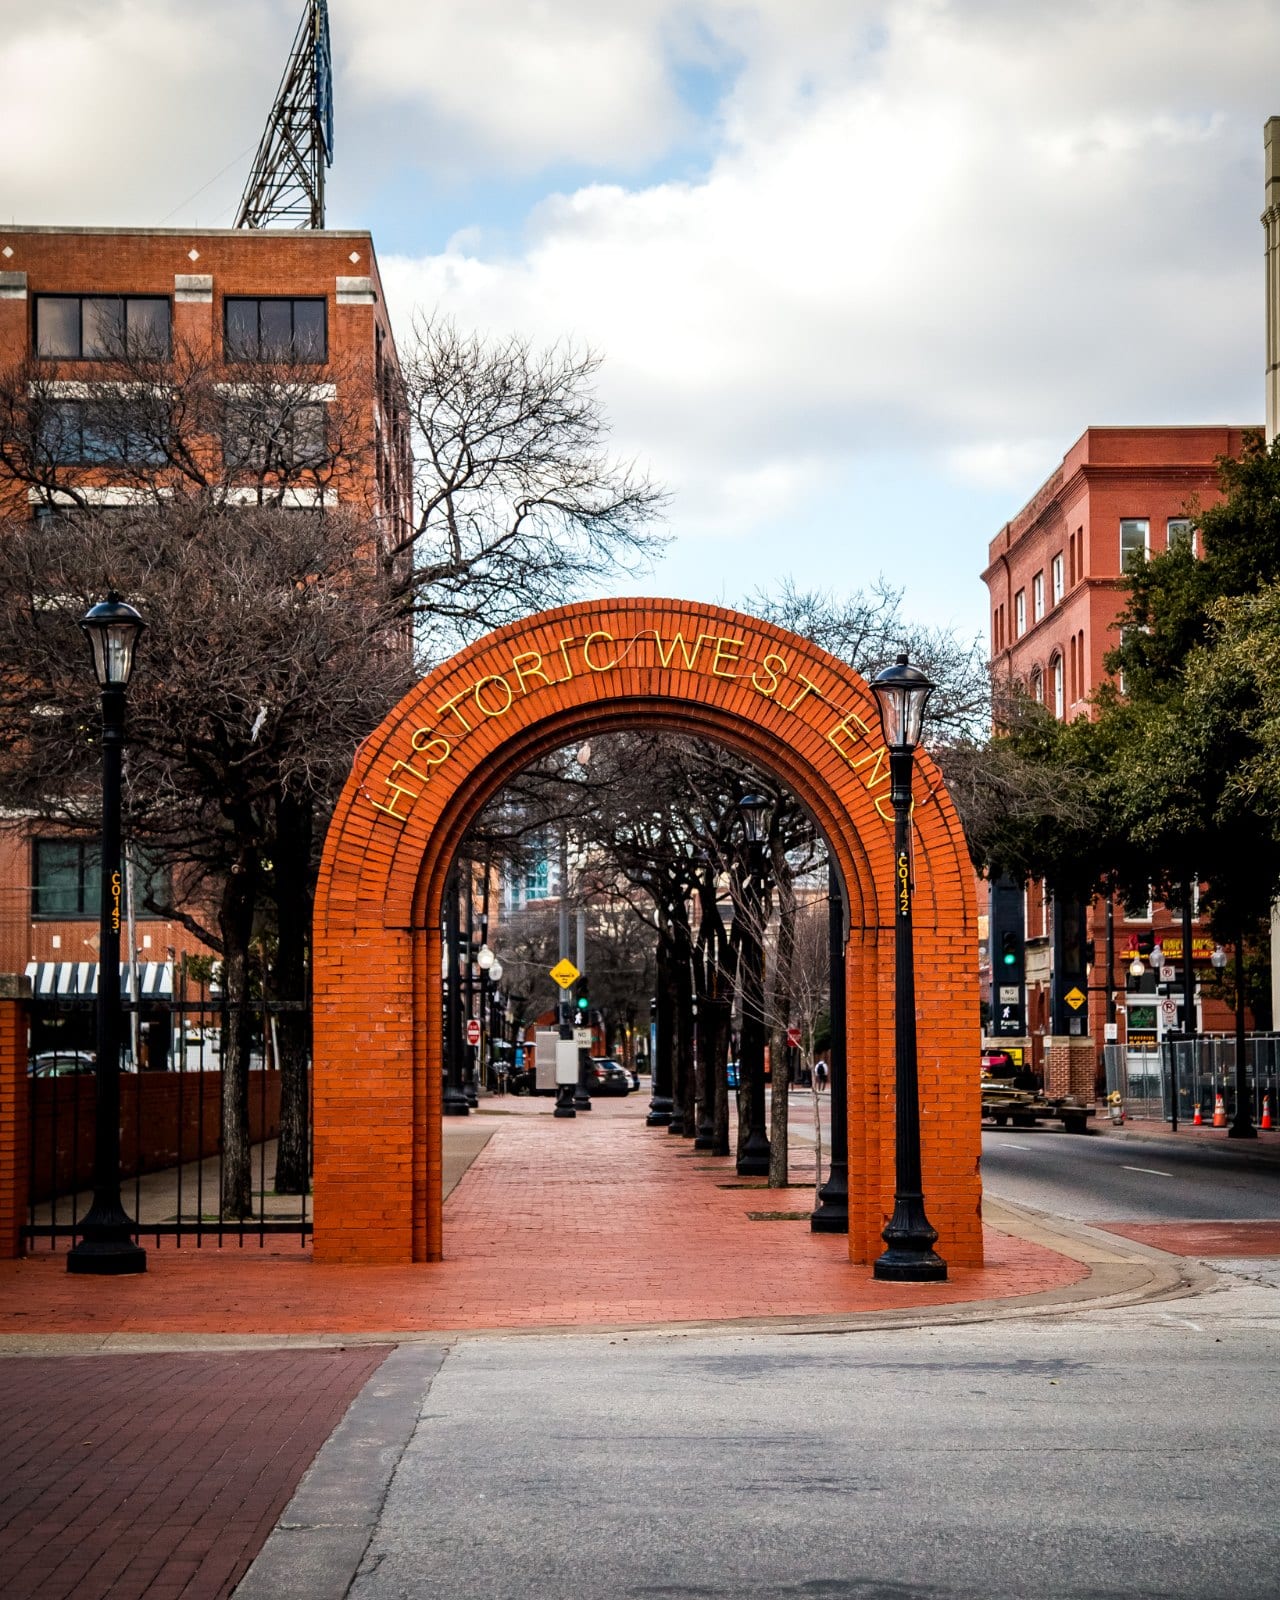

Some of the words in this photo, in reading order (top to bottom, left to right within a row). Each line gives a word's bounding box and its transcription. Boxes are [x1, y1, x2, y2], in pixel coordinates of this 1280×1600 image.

[371, 630, 615, 822] HISTORIC
[654, 630, 823, 712] WEST
[111, 872, 121, 930] C0143
[898, 855, 909, 911] C0142
